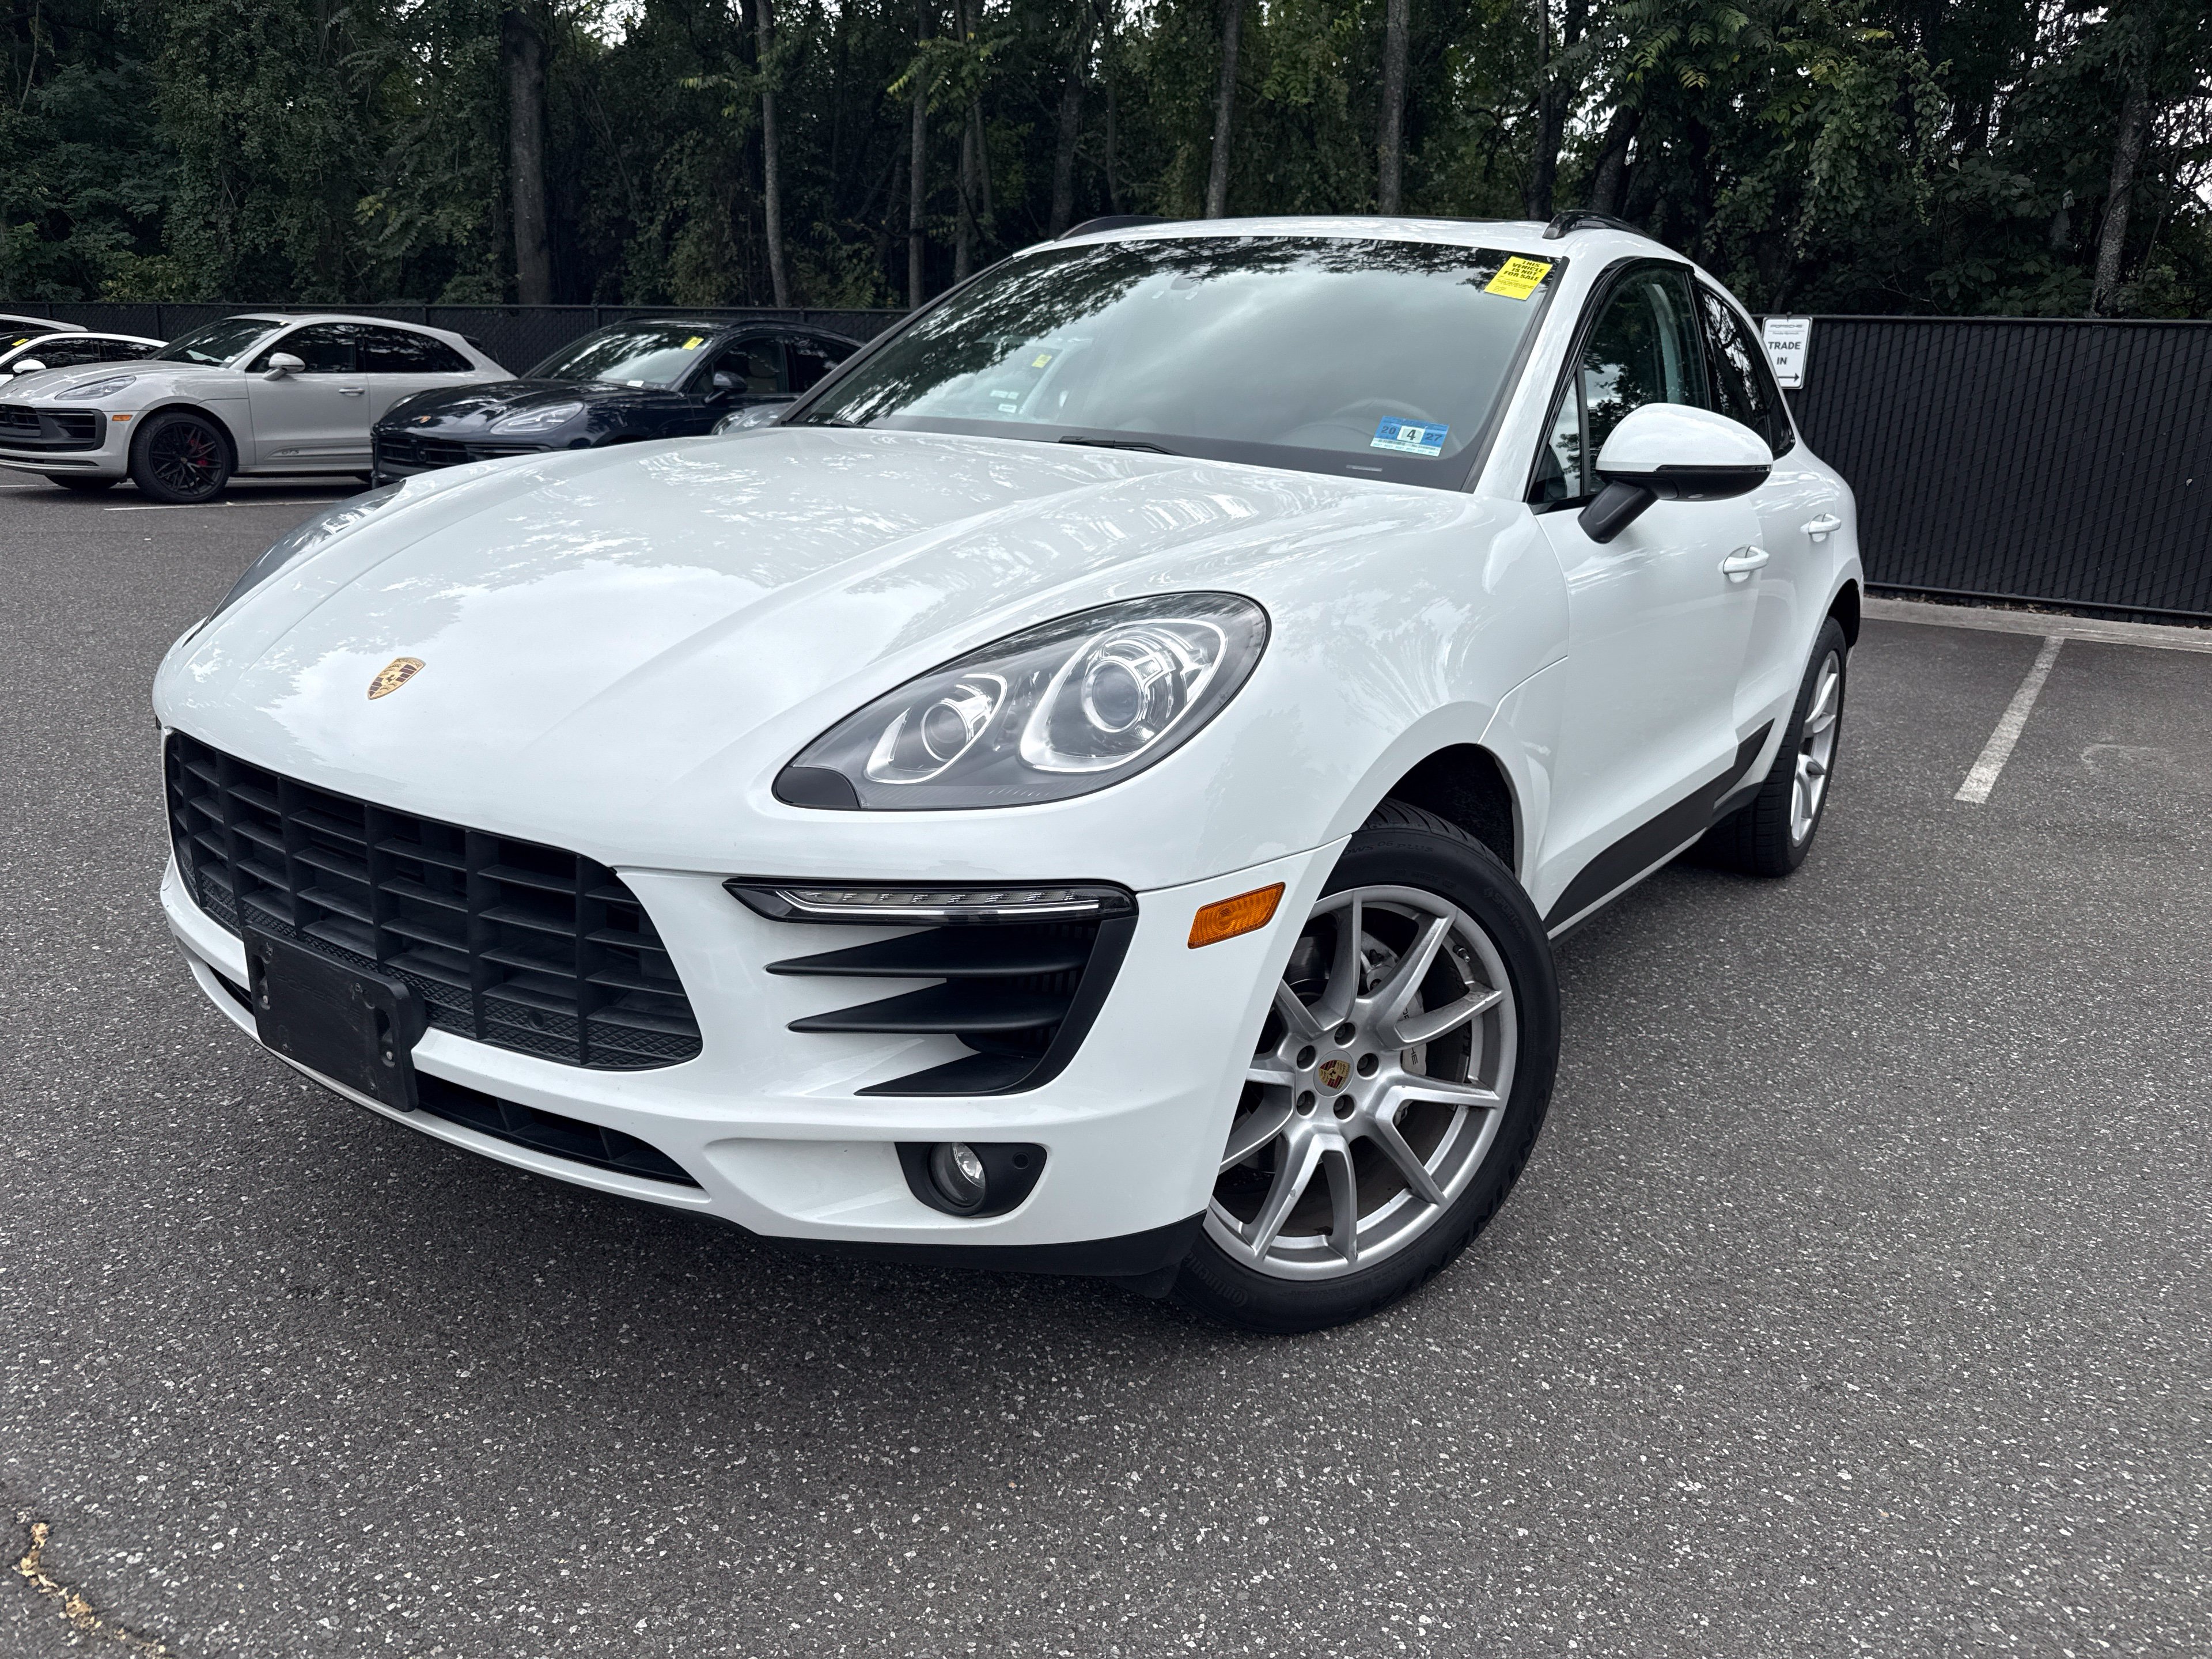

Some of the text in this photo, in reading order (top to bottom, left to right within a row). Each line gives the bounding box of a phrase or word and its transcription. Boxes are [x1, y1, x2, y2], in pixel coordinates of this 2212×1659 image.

[1512, 263, 1545, 273] VEHICLE
[1768, 342, 1801, 350] TRADE
[1777, 357, 1787, 365] IN
[1381, 426, 1443, 442] 20 4 27
[1182, 1249, 1251, 1310] Continenta
